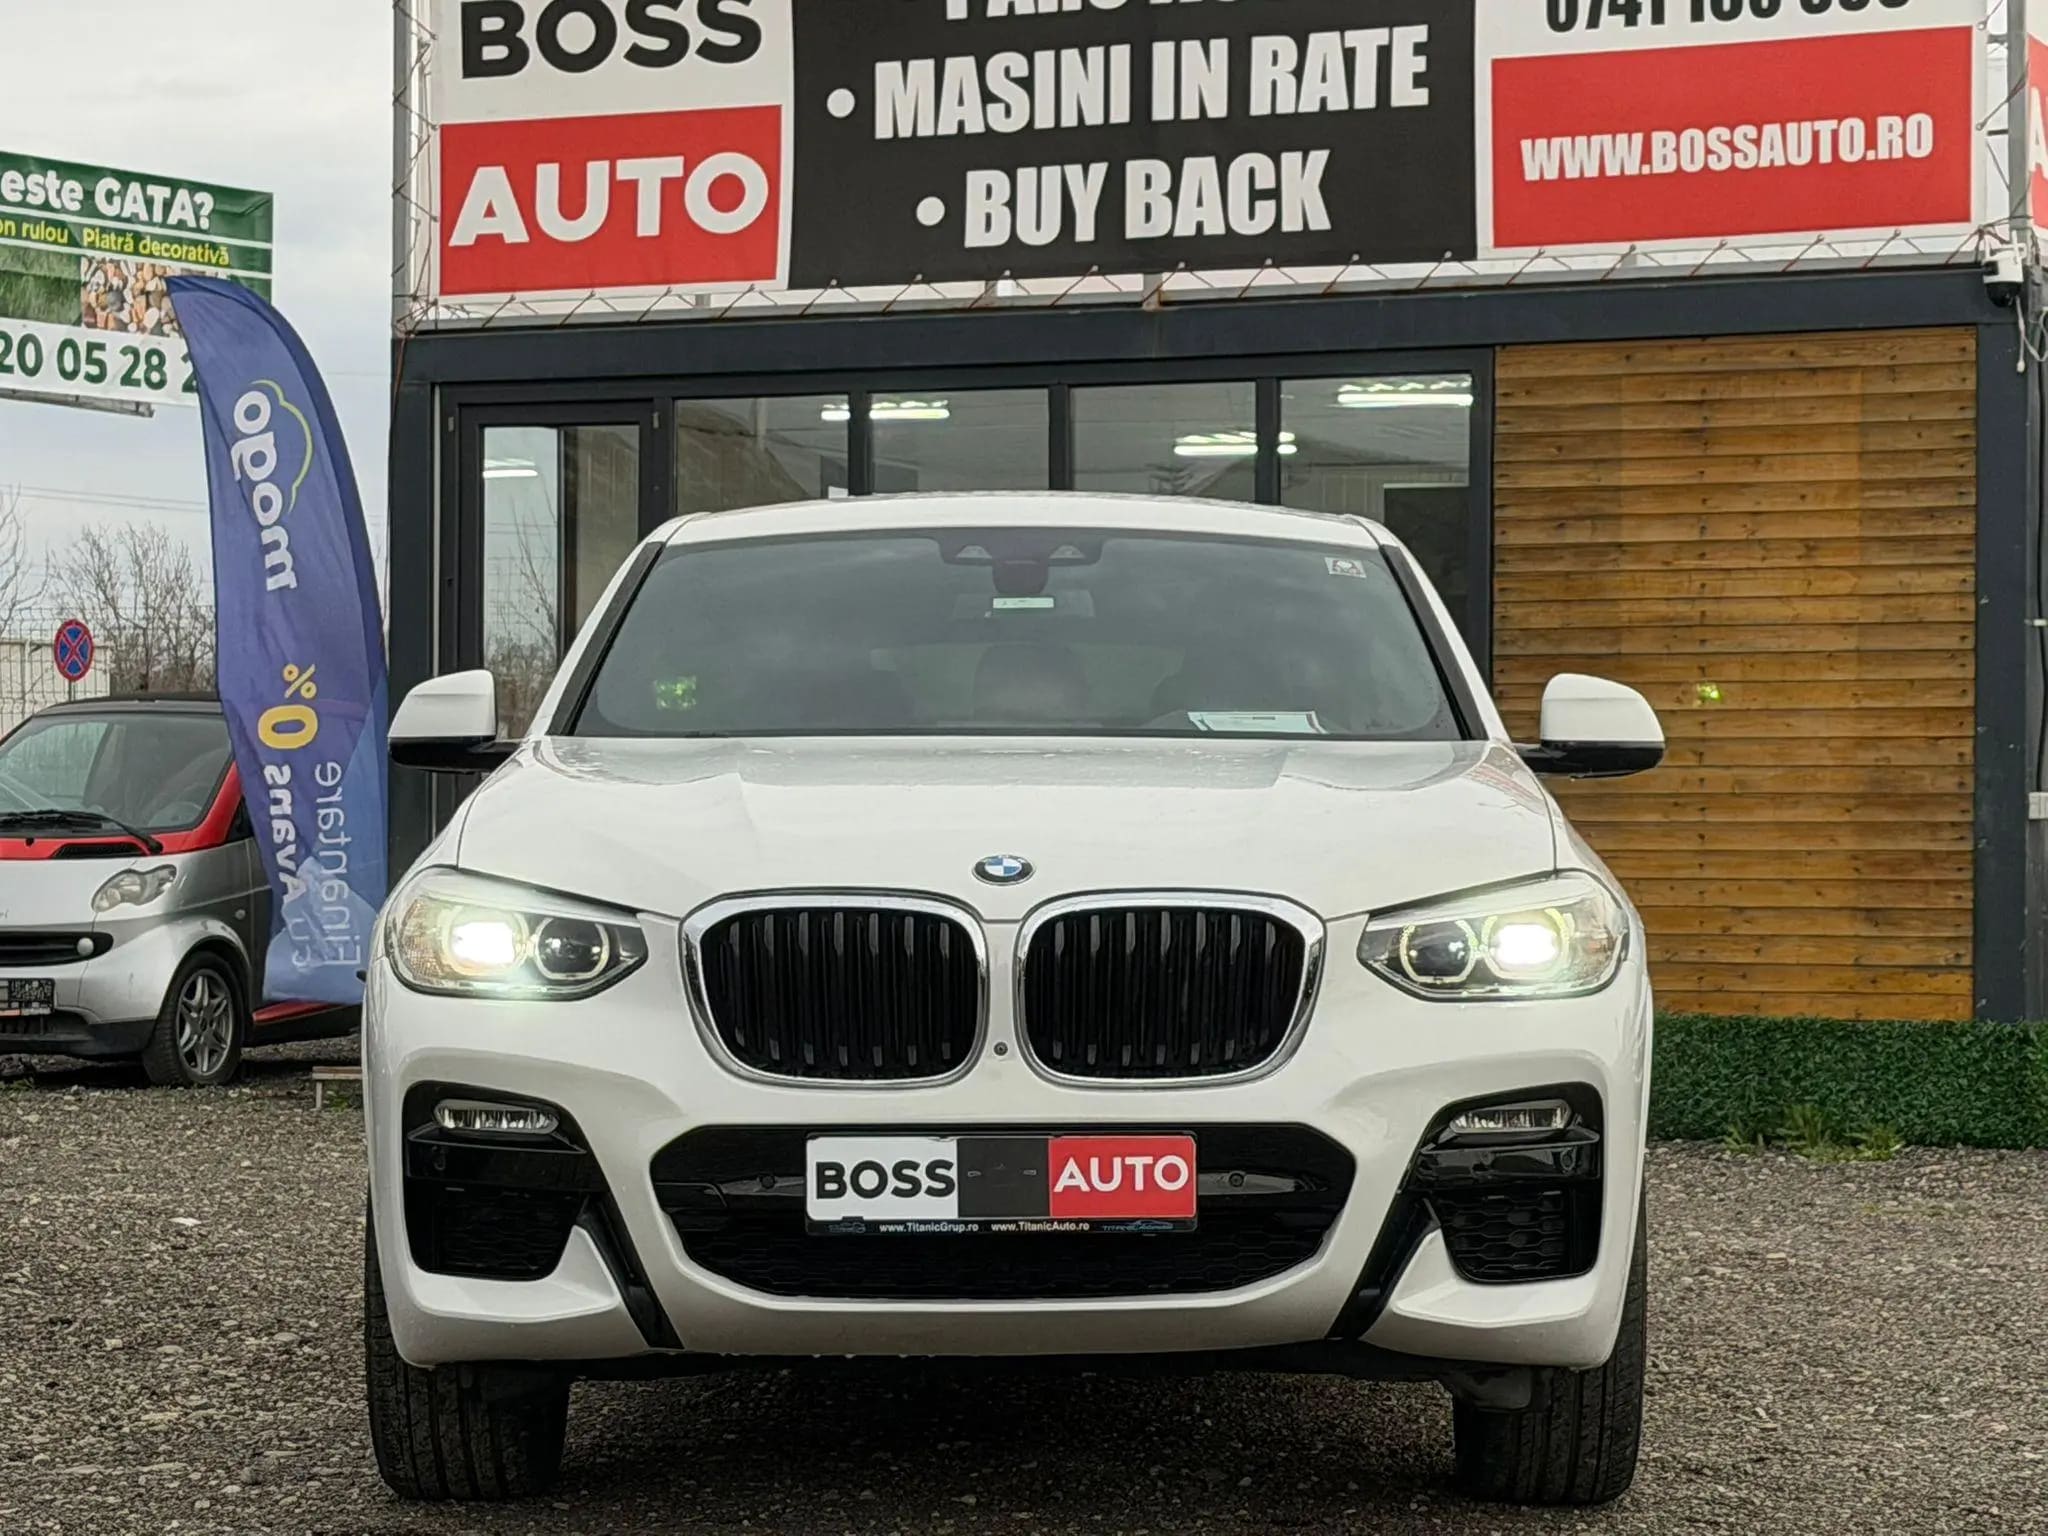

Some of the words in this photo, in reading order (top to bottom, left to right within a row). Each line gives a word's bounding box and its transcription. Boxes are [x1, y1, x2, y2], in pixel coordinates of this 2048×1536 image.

[461, 0, 761, 78] BOSS
[875, 45, 1131, 140] MASINI
[1152, 38, 1229, 121] IN
[1250, 24, 1430, 115] RATE
[1520, 113, 1934, 181] WWW.BOSSAUTO.RO
[1, 169, 84, 211] este
[94, 177, 215, 230] GATA?
[448, 152, 769, 247] AUTO
[965, 162, 1109, 248] BUY
[1125, 149, 1332, 239] BACK
[21, 221, 68, 244] rulou
[57, 337, 108, 384] 05
[119, 345, 168, 390] 28
[815, 1159, 956, 1200] BOSS
[1053, 1155, 1190, 1193] AUTO
[879, 1222, 979, 1233] www.TitanicGrup.ro
[991, 1221, 1090, 1232] www.TitanicAuto.ro
